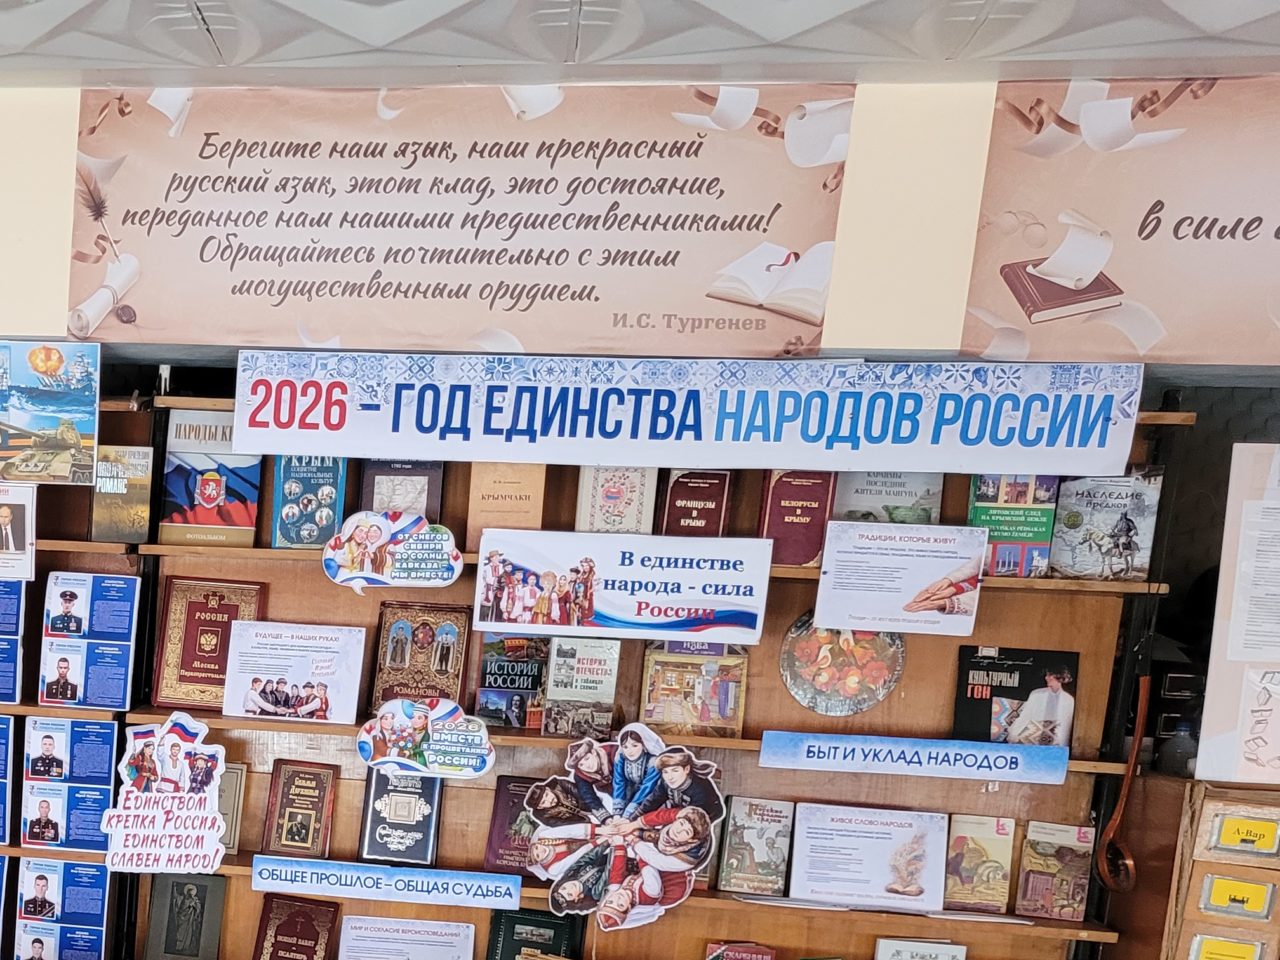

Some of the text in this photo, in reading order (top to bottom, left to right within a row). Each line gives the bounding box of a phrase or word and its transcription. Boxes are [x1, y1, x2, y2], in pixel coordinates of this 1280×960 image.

[198, 131, 705, 169] Берегите наш язык, наш прекрасный
[164, 168, 726, 203] русский язык, этот клад, это достояние,
[121, 203, 781, 243] переданное нам нашими предшественниками!
[1136, 199, 1262, 242] в силе
[198, 234, 679, 270] Обращайтесь почтительно с этим
[230, 276, 601, 312] могущественным орудием.
[611, 312, 767, 335] И.С. Тургенев
[247, 378, 1115, 450] 2026 ГОД ЕДИНСТВА НАРОДОВ РОССИИ
[174, 423, 219, 444] НАРОДЫ
[291, 455, 334, 468] КРЫМ
[481, 493, 531, 502] КРЫМЧАКИ
[1075, 489, 1144, 501] НАСЛЕДИЕ
[675, 499, 716, 509] ФРАНЦУЗЫ
[780, 500, 819, 509] БЕЛОРУСЫ
[397, 533, 449, 541] ОТ СНЕГОВ
[403, 542, 443, 551] СИБИРИ
[395, 551, 449, 561] ДО СОЛНЦА
[619, 551, 745, 573] В единстве
[395, 561, 438, 570] КАВКАЗА
[391, 571, 453, 581] МЫ ВМЕСТЕ!
[603, 578, 755, 598] народа сила
[195, 611, 229, 623] РОССИЯ
[634, 600, 718, 621] России
[486, 660, 539, 676] ИСТОРИЯ
[485, 674, 533, 690] РОССИИ
[967, 669, 1020, 688] КУЛЬТУРНЫЙ
[392, 686, 441, 698] РОМАНОВЫ
[433, 721, 481, 731] 2026
[432, 733, 483, 744] ВМЕСТЕ
[428, 754, 481, 767] РОССИИ!
[806, 745, 1019, 772] БЫТ И УКЛАД НАРОДОВ
[258, 868, 513, 899] ОБЩЕЕ ПРОШЛОЕ ОБЩАЯ СУДЬБА
